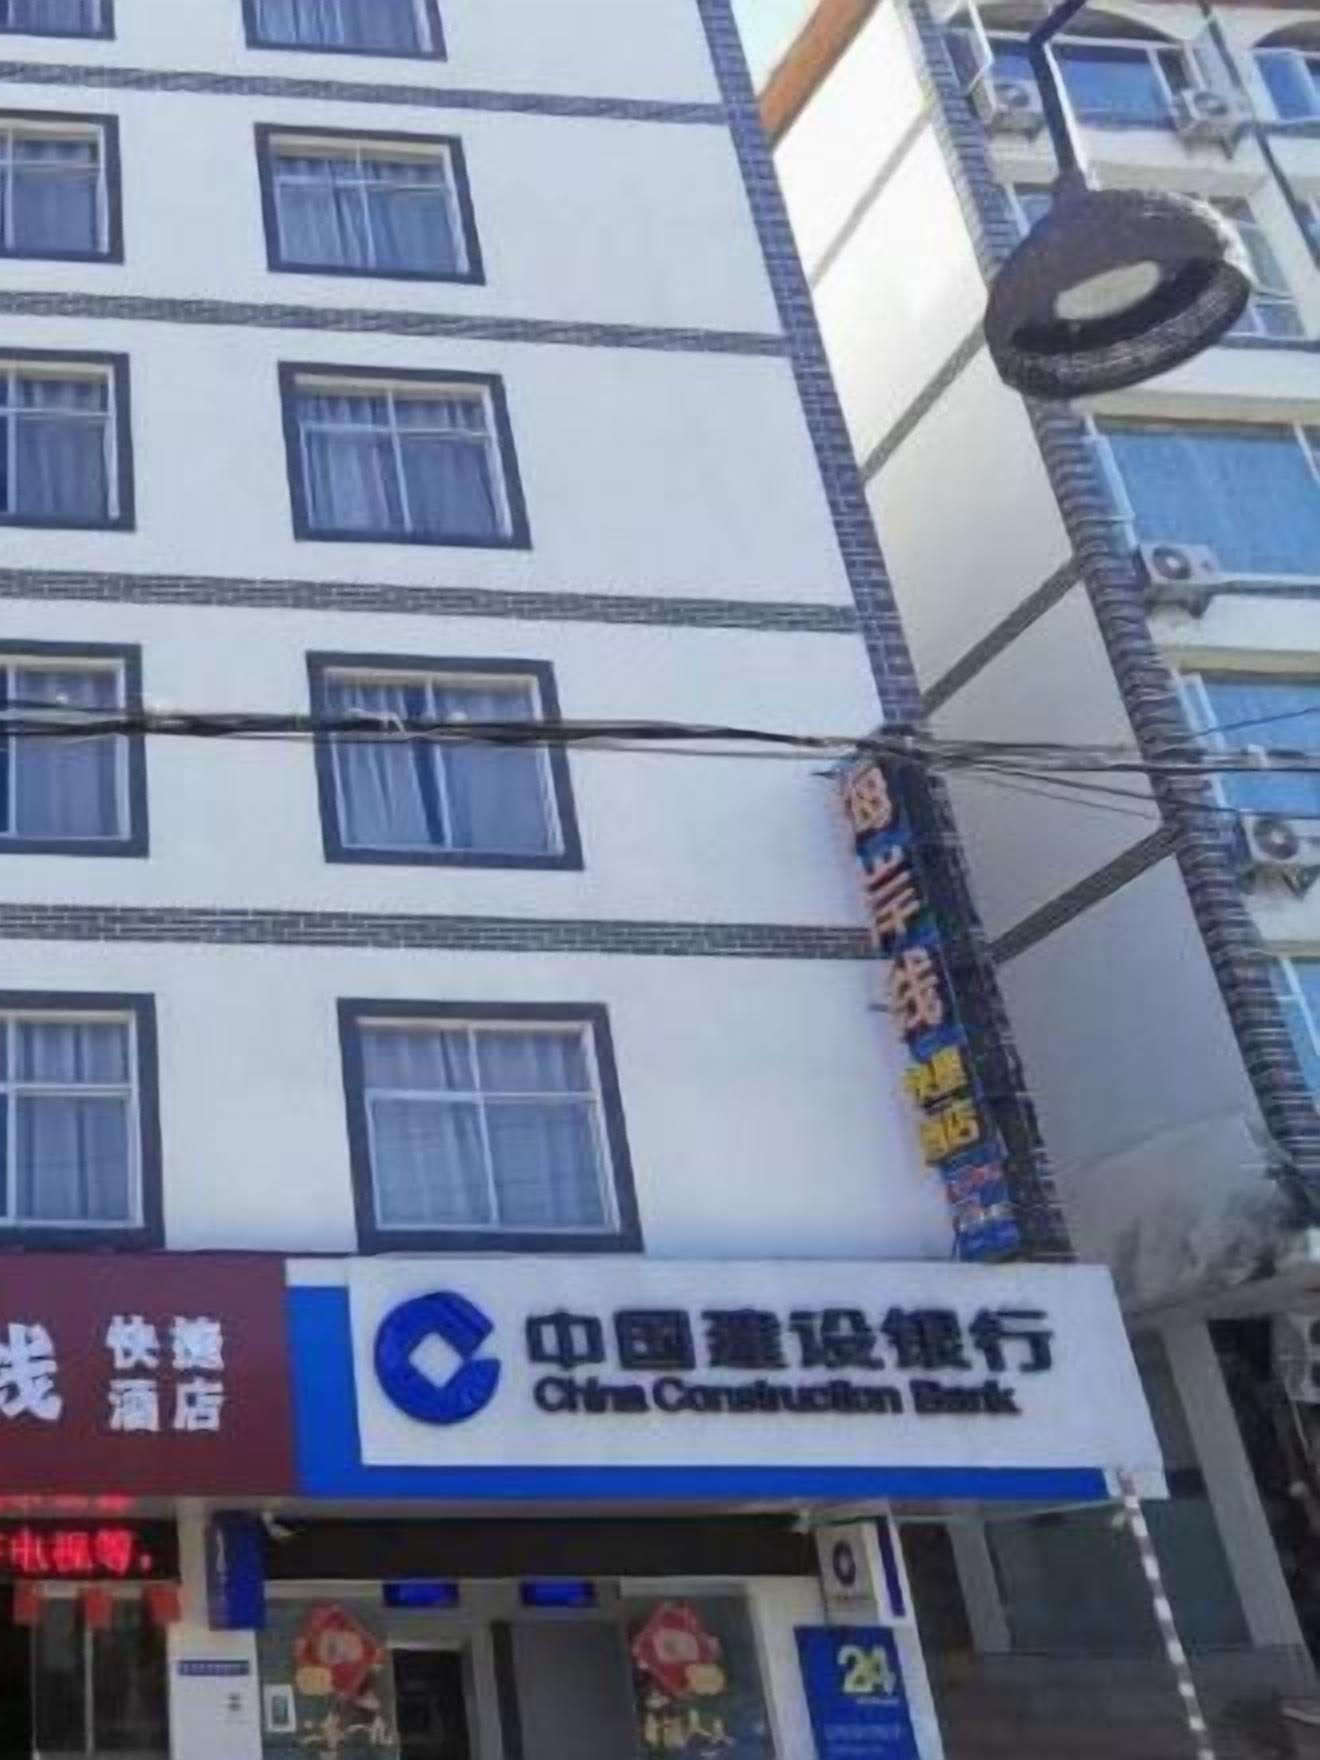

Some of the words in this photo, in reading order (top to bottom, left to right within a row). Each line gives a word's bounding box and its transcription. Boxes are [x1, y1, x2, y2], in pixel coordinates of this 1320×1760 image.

[105, 1314, 225, 1370] 快捷
[526, 1307, 1054, 1373] 中国建设银行
[108, 1376, 226, 1432] 酒店
[533, 1375, 649, 1415] China
[652, 1375, 904, 1415] Construction
[909, 1380, 1022, 1415] Bank
[837, 1645, 896, 1696] 24
